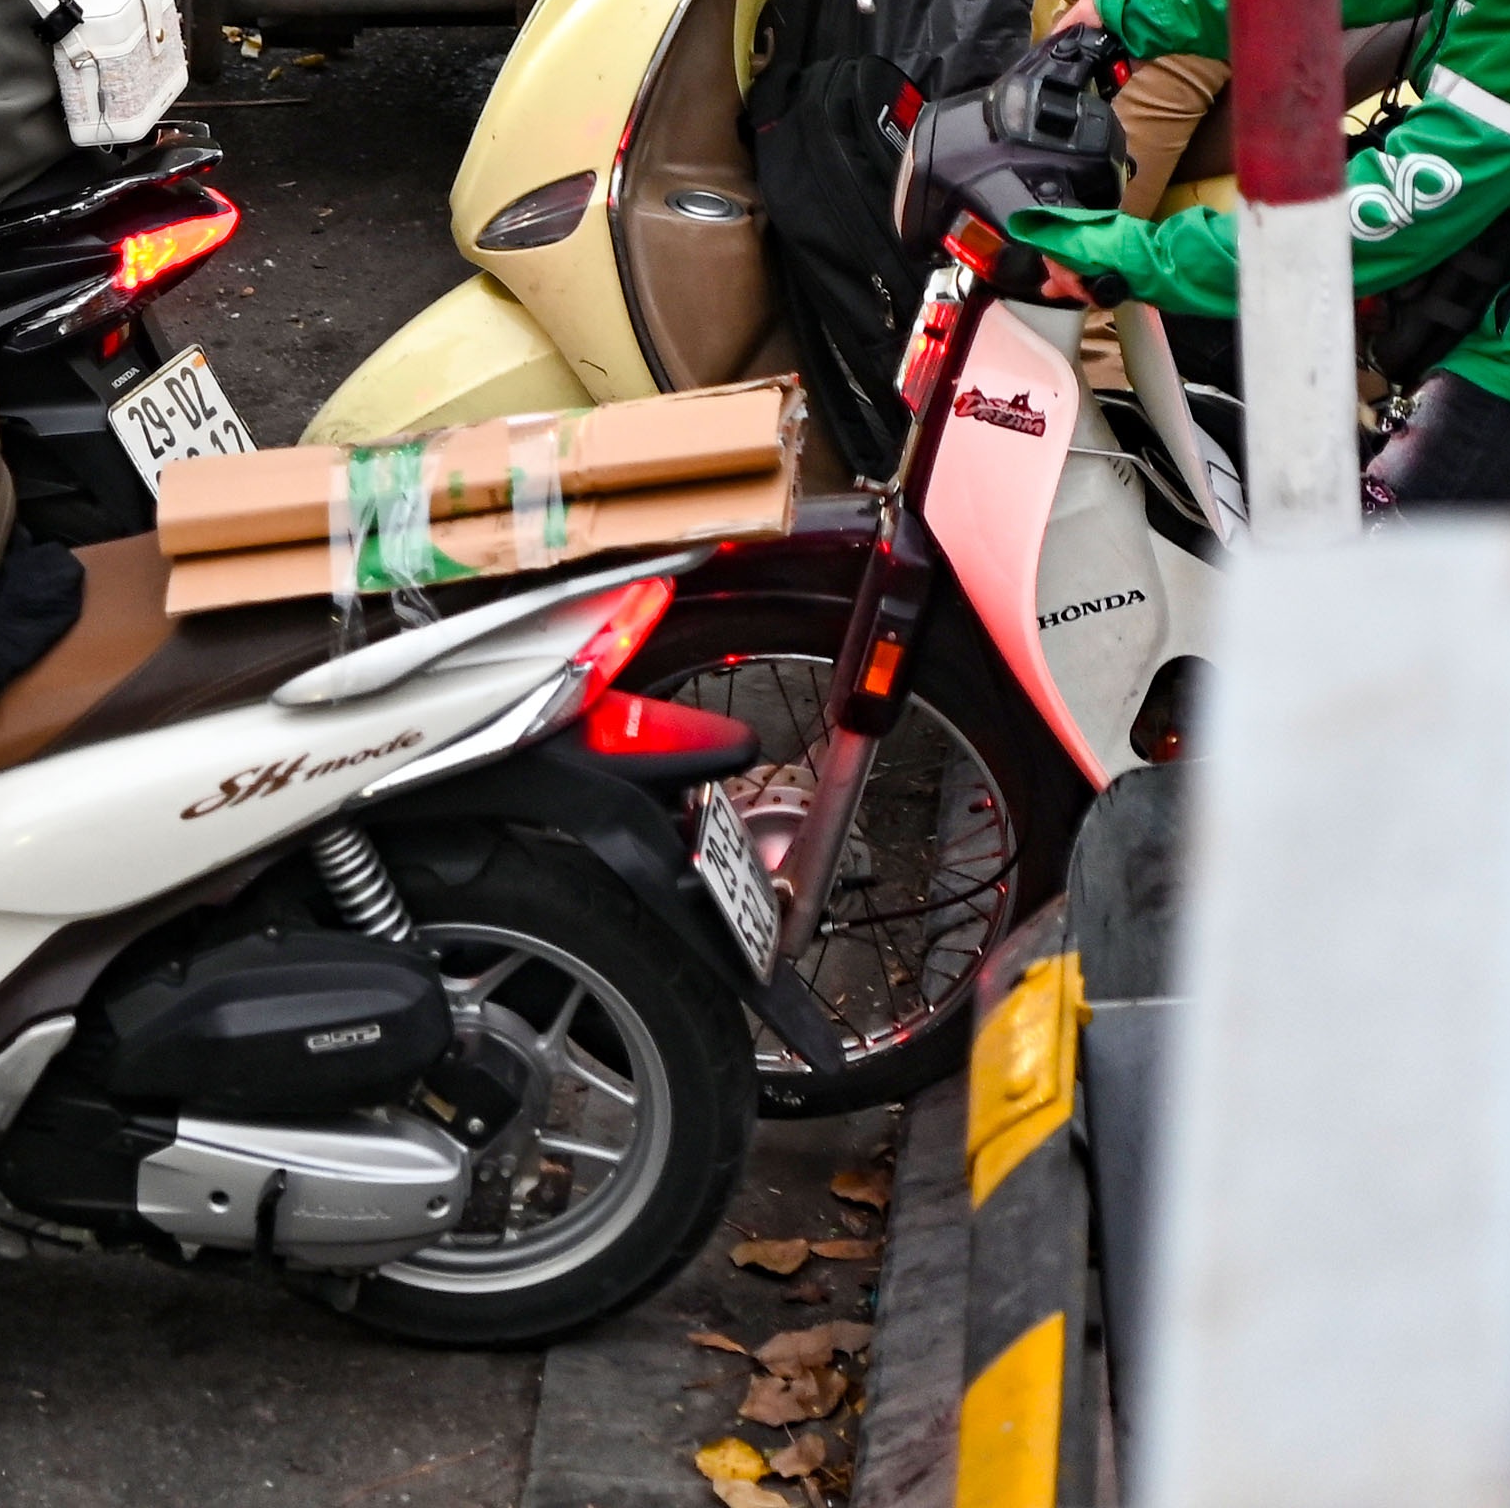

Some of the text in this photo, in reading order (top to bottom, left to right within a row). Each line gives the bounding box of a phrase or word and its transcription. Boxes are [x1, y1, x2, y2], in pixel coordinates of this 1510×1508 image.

[128, 366, 218, 460] 29-D2
[1036, 588, 1147, 631] HONDA
[179, 729, 425, 821] SH mode
[704, 795, 746, 904] 29-E2
